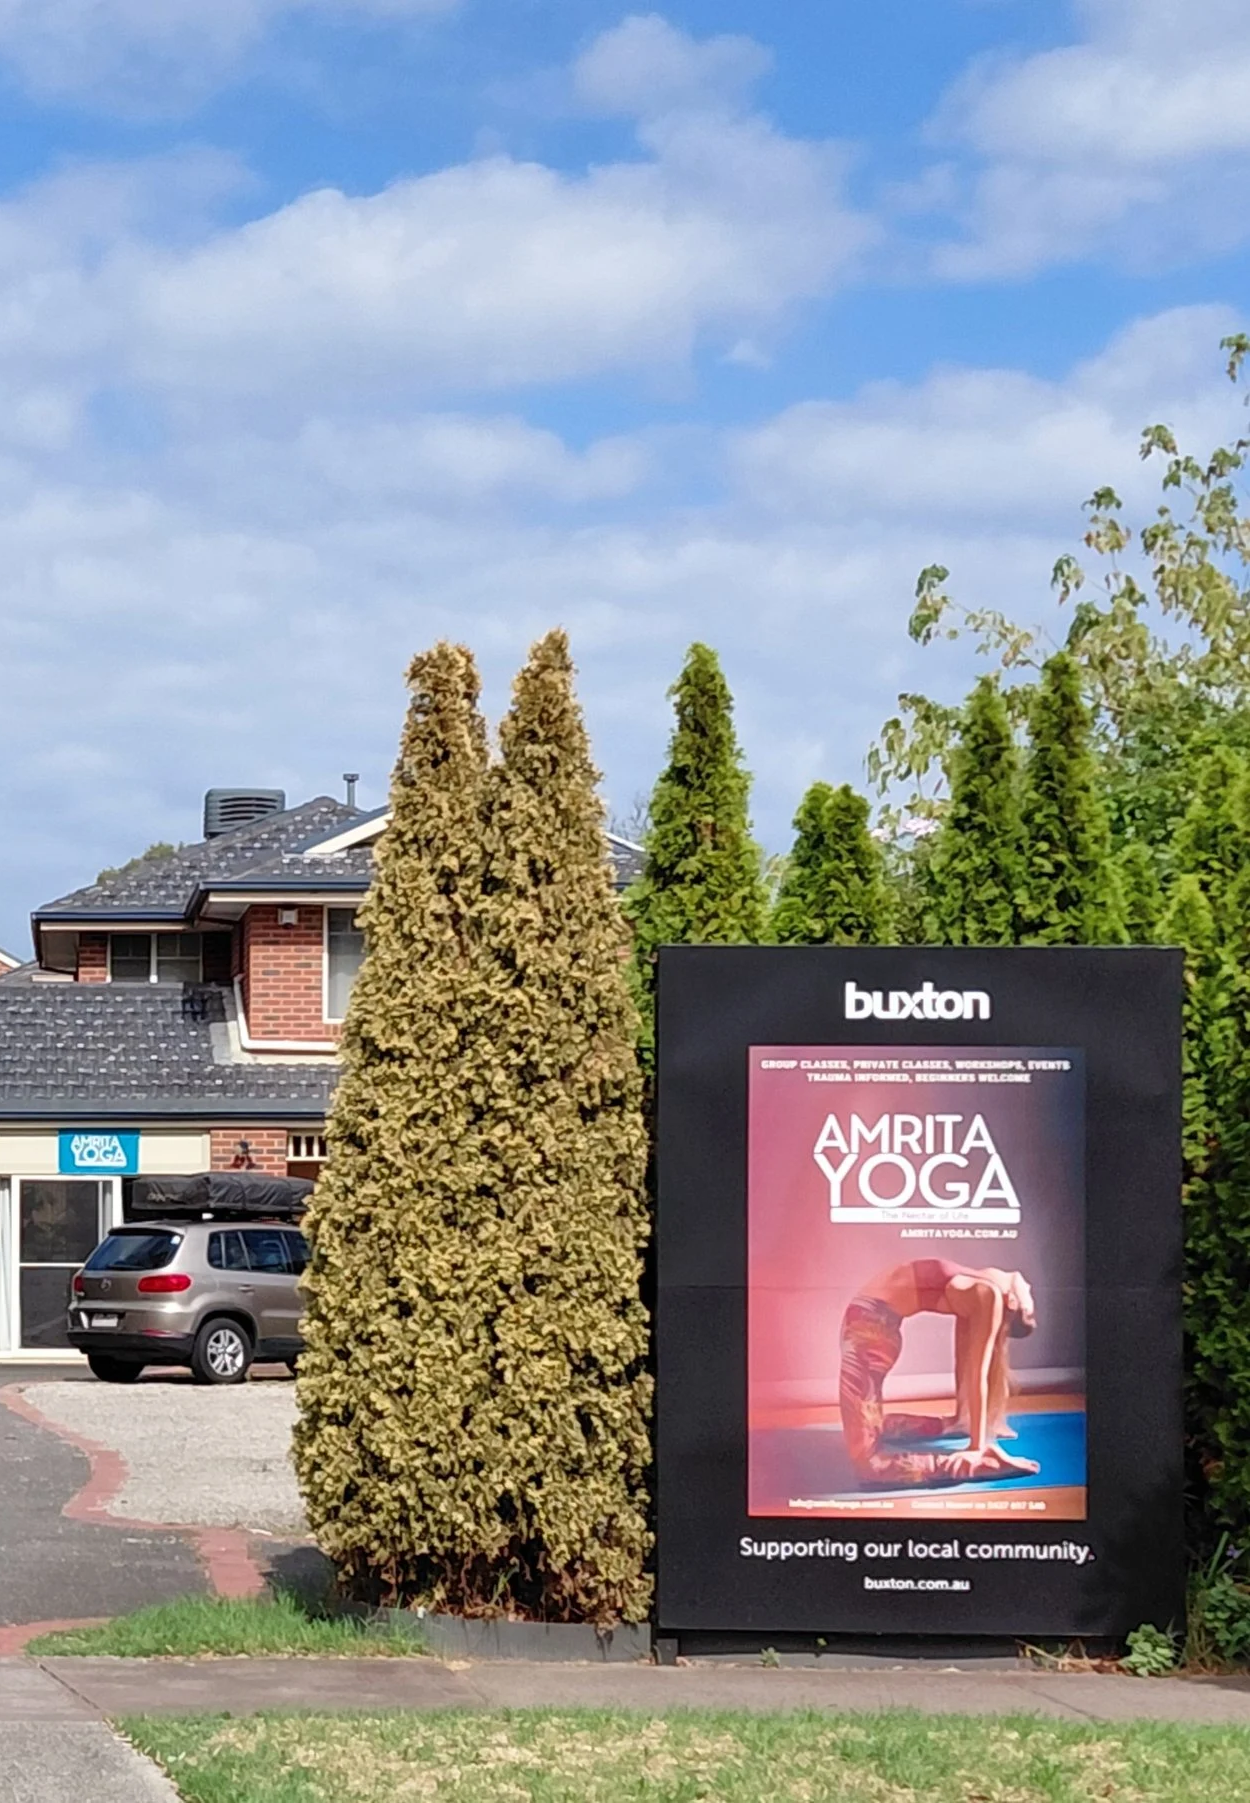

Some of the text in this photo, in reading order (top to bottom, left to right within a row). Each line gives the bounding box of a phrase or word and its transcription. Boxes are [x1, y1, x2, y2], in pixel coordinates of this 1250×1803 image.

[845, 981, 990, 1019] buxton
[761, 1060, 798, 1069] GROUP
[853, 1060, 899, 1069] PRIVATE
[1028, 1060, 1071, 1070] EVENTS
[978, 1073, 1031, 1083] WELCOME
[71, 1135, 118, 1147] AMRITA
[813, 1113, 997, 1154] AMRITA
[71, 1146, 127, 1161] YOGA
[813, 1153, 1021, 1208] YOGA
[740, 1537, 1095, 1564] Supporting our local community.
[864, 1576, 970, 1591] buxton.com.au
